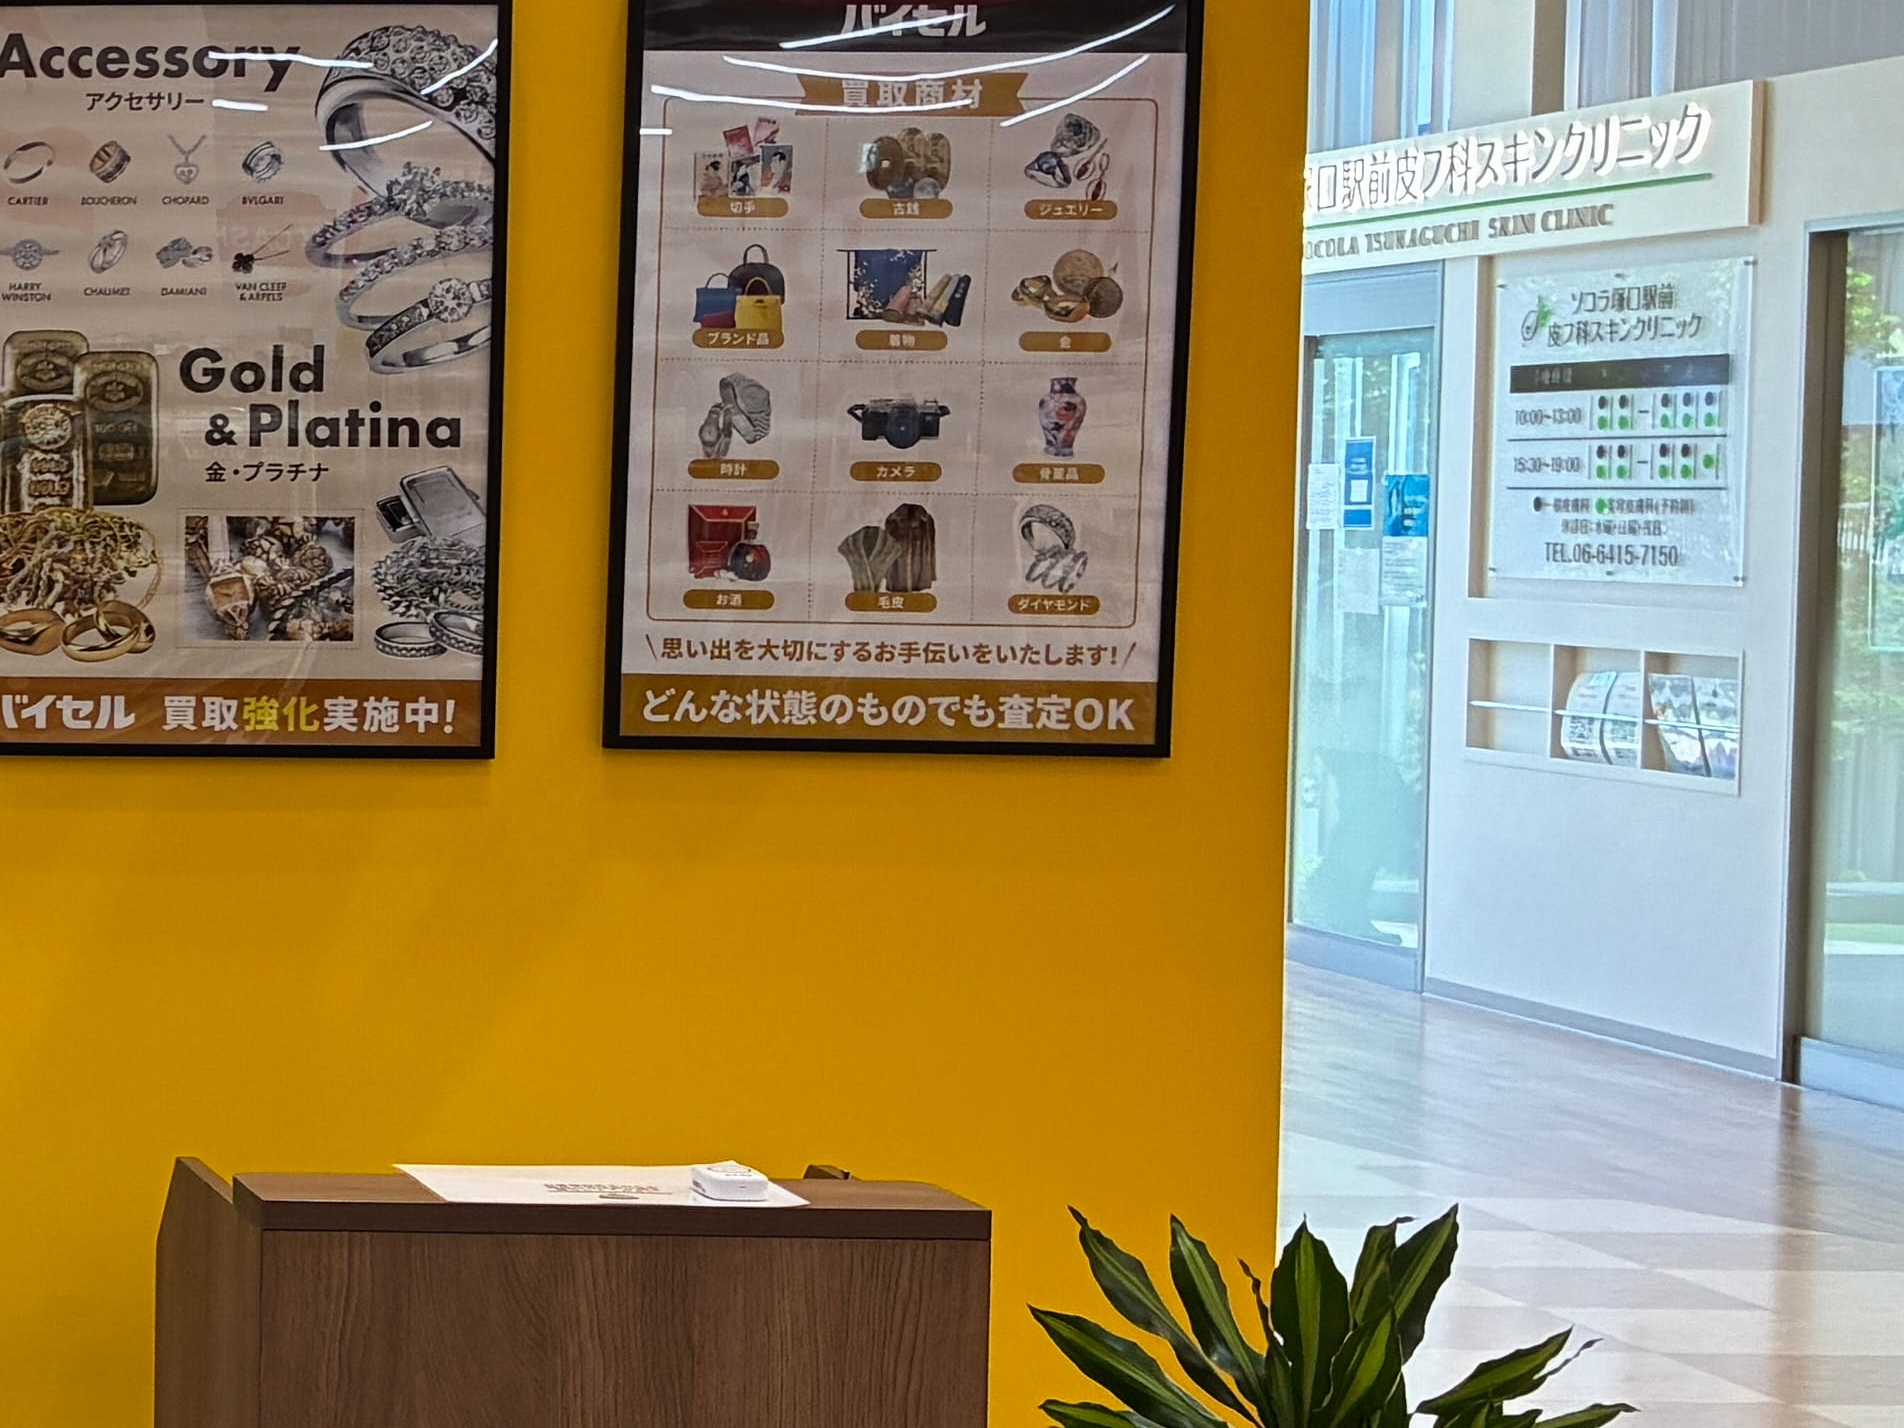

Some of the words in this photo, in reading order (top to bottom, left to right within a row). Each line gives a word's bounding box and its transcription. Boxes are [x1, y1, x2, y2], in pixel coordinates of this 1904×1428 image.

[841, 4, 987, 37] バイセル
[86, 92, 205, 112] アクセサリー
[842, 78, 983, 109] 買取商材
[8, 196, 49, 206] CARTIER
[730, 201, 756, 215] 切手
[1039, 202, 1103, 217] ジュエリー
[1488, 207, 1536, 240] SKIN
[1541, 203, 1614, 233] CLINIC
[1, 292, 52, 302] WINSTON
[1571, 284, 1676, 315] ソコラ塚口駅前
[708, 332, 770, 347] ブランド品
[1548, 313, 1702, 348] 皮フ科スキンクリニック
[178, 344, 325, 394] Gold
[205, 413, 237, 448] &
[249, 401, 461, 449] Platina
[205, 461, 329, 483] 金・プラチナ
[876, 465, 916, 479] カメラ
[1018, 597, 1090, 613] ダイヤモンド
[641, 688, 1135, 732] どんな状態のものでも査定OK
